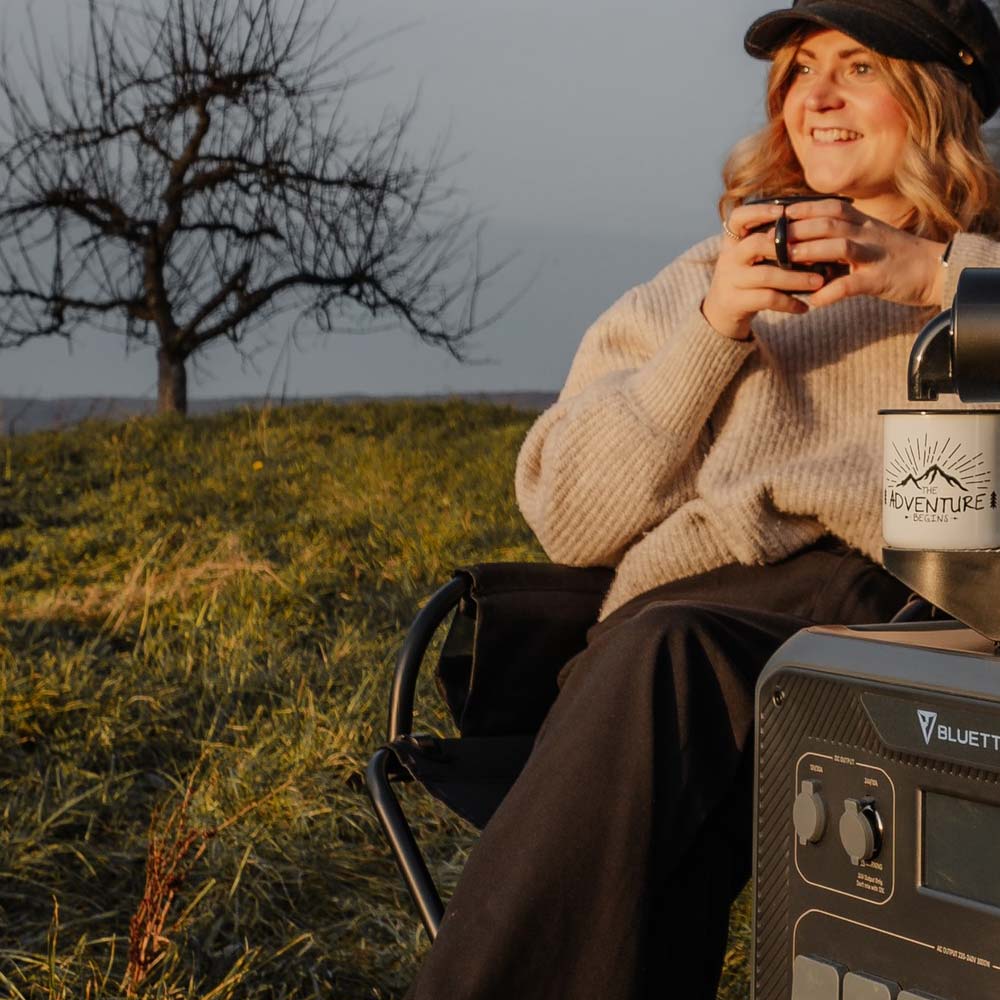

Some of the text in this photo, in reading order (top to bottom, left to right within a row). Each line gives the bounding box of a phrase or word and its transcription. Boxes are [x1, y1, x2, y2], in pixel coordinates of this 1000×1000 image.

[922, 486, 938, 495] THE
[889, 489, 987, 513] ADVENTURE
[913, 514, 949, 523] BEGINS
